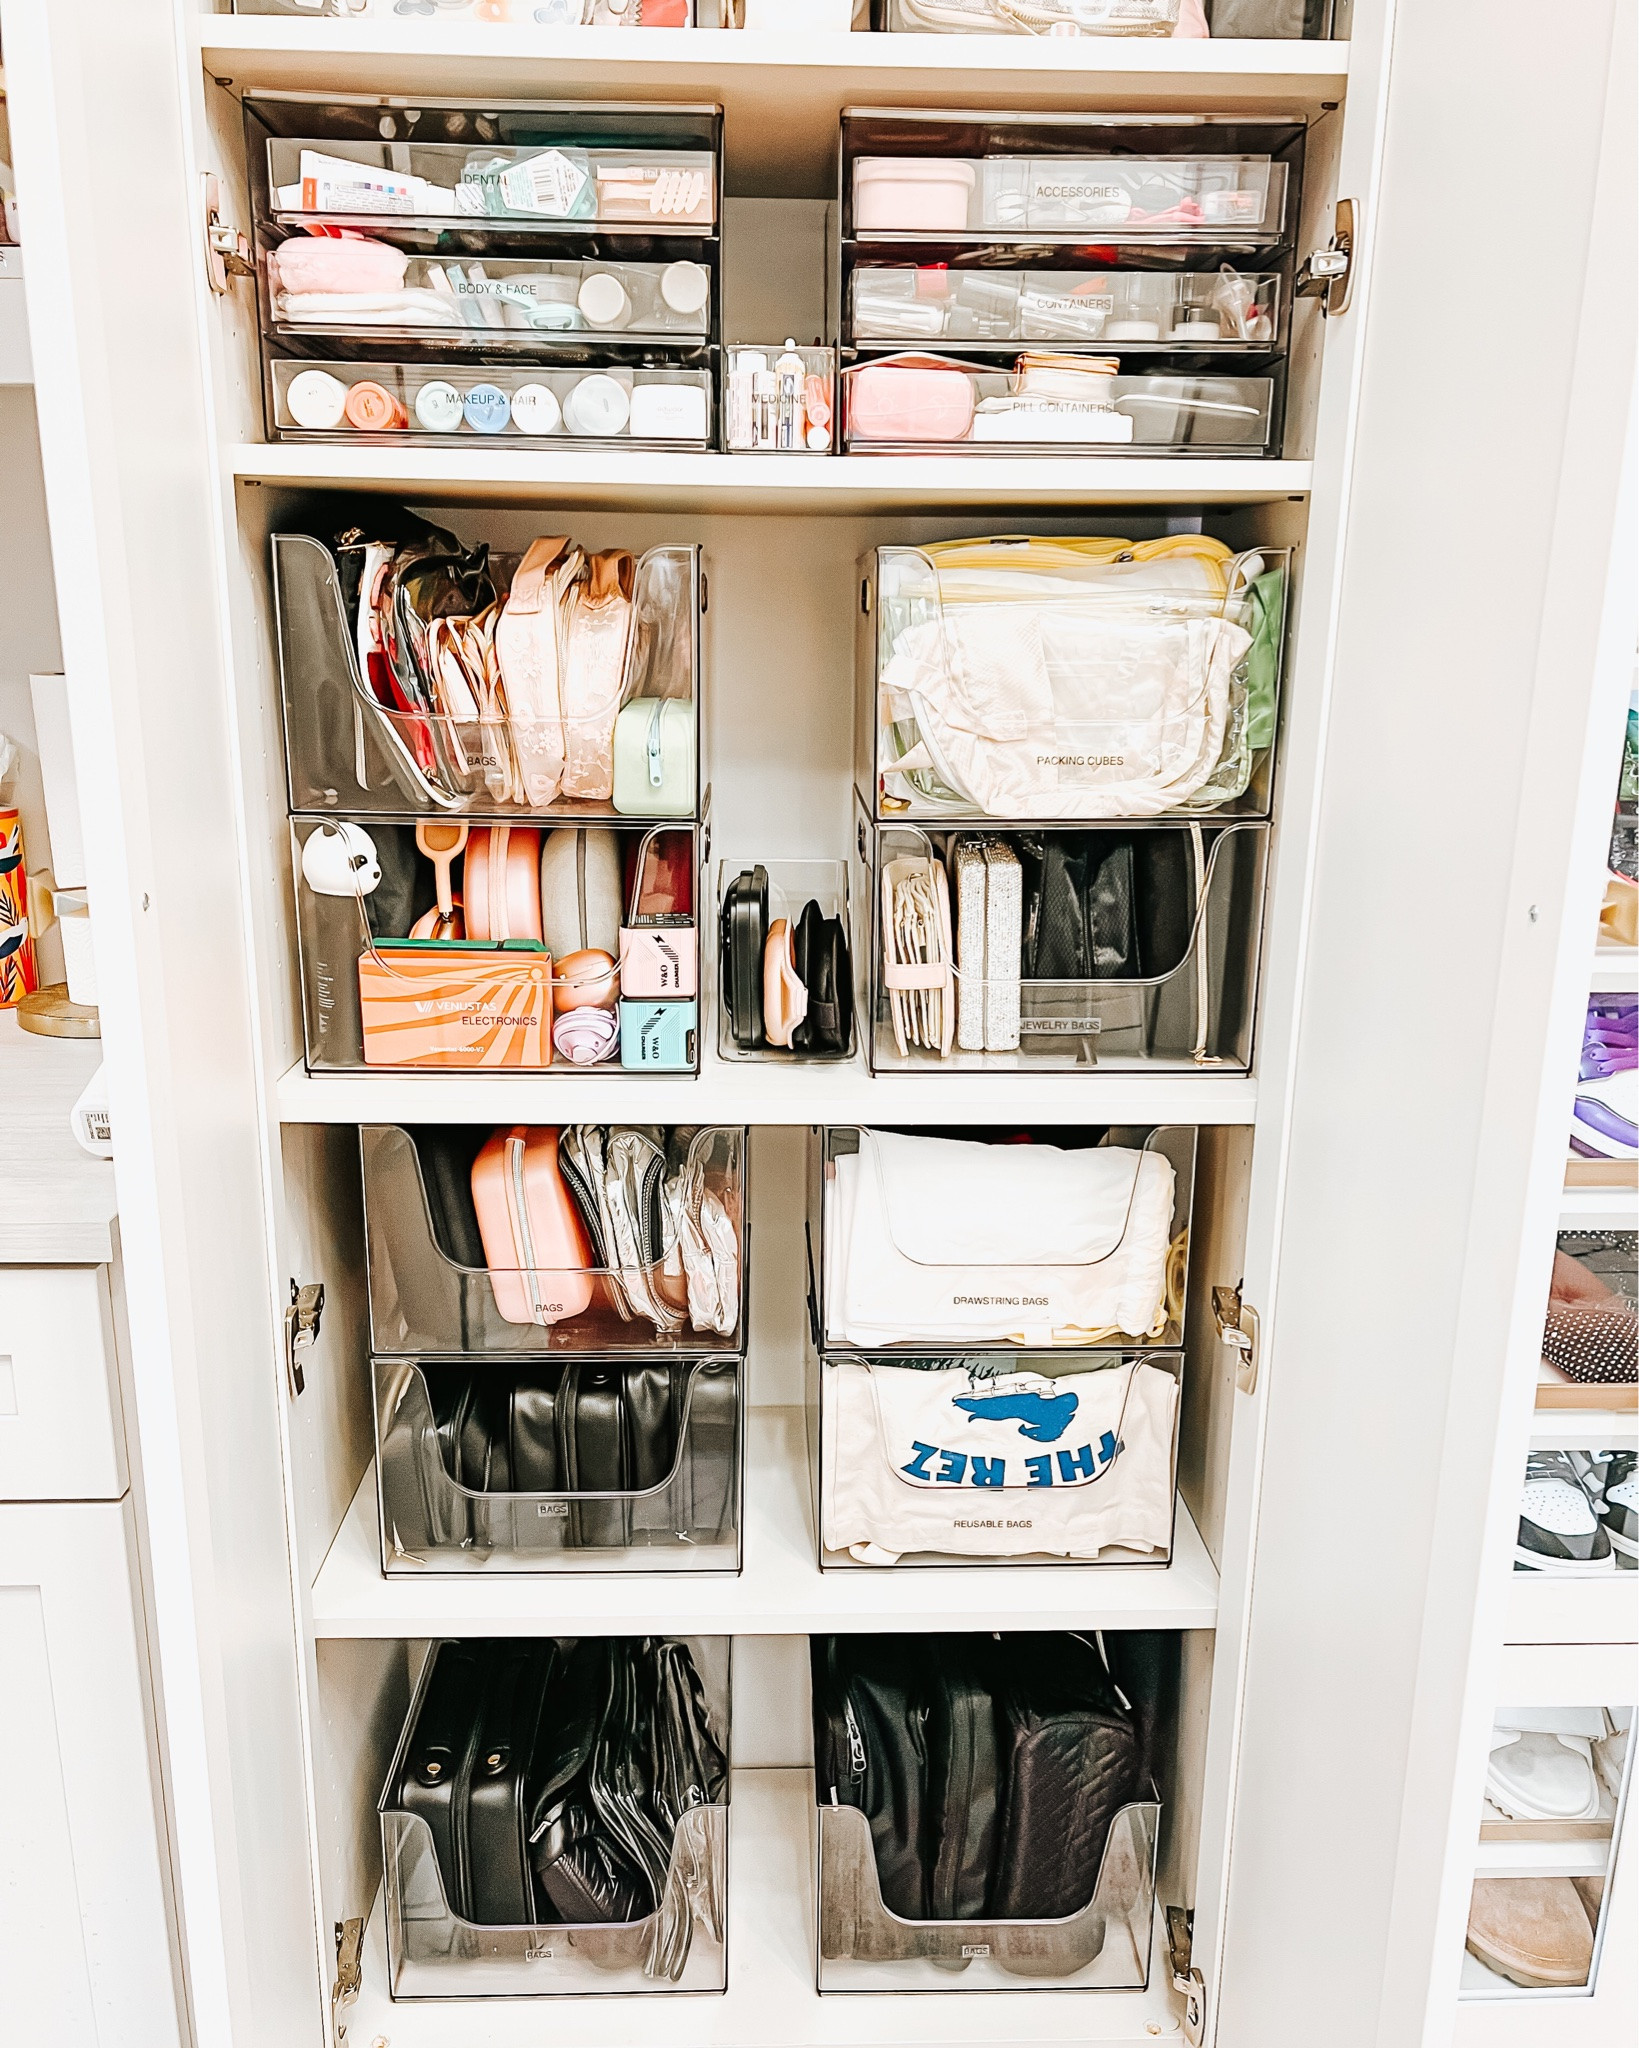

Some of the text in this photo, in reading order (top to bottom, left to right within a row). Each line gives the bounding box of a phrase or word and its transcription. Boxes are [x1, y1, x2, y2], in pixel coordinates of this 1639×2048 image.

[1036, 186, 1120, 197] ACCESSORIES
[458, 283, 537, 295] BODY & FACE
[1037, 298, 1111, 309] CONTAINERS
[446, 393, 537, 406] MAKEUP & HAIR
[751, 394, 807, 404] MEDICINE
[1013, 401, 1113, 413] PILL CONTAINERS
[467, 756, 497, 766] BAGS
[1036, 756, 1124, 766] PACKING CUBES
[660, 964, 668, 988] W&O
[436, 1001, 497, 1011] VENUSTAS
[462, 1016, 538, 1026] ELECTRONICS
[1020, 1021, 1100, 1030] JEWELRY BAGS
[652, 1037, 660, 1059] W&O
[953, 1296, 1049, 1306] DRAWSTRING BAGS
[535, 1303, 564, 1312] BAGS
[901, 1429, 1126, 1487] THE REZ
[540, 1505, 567, 1514] BAGS
[953, 1520, 1033, 1528] REUSABLE BAGS
[527, 1950, 552, 1959] BAGS
